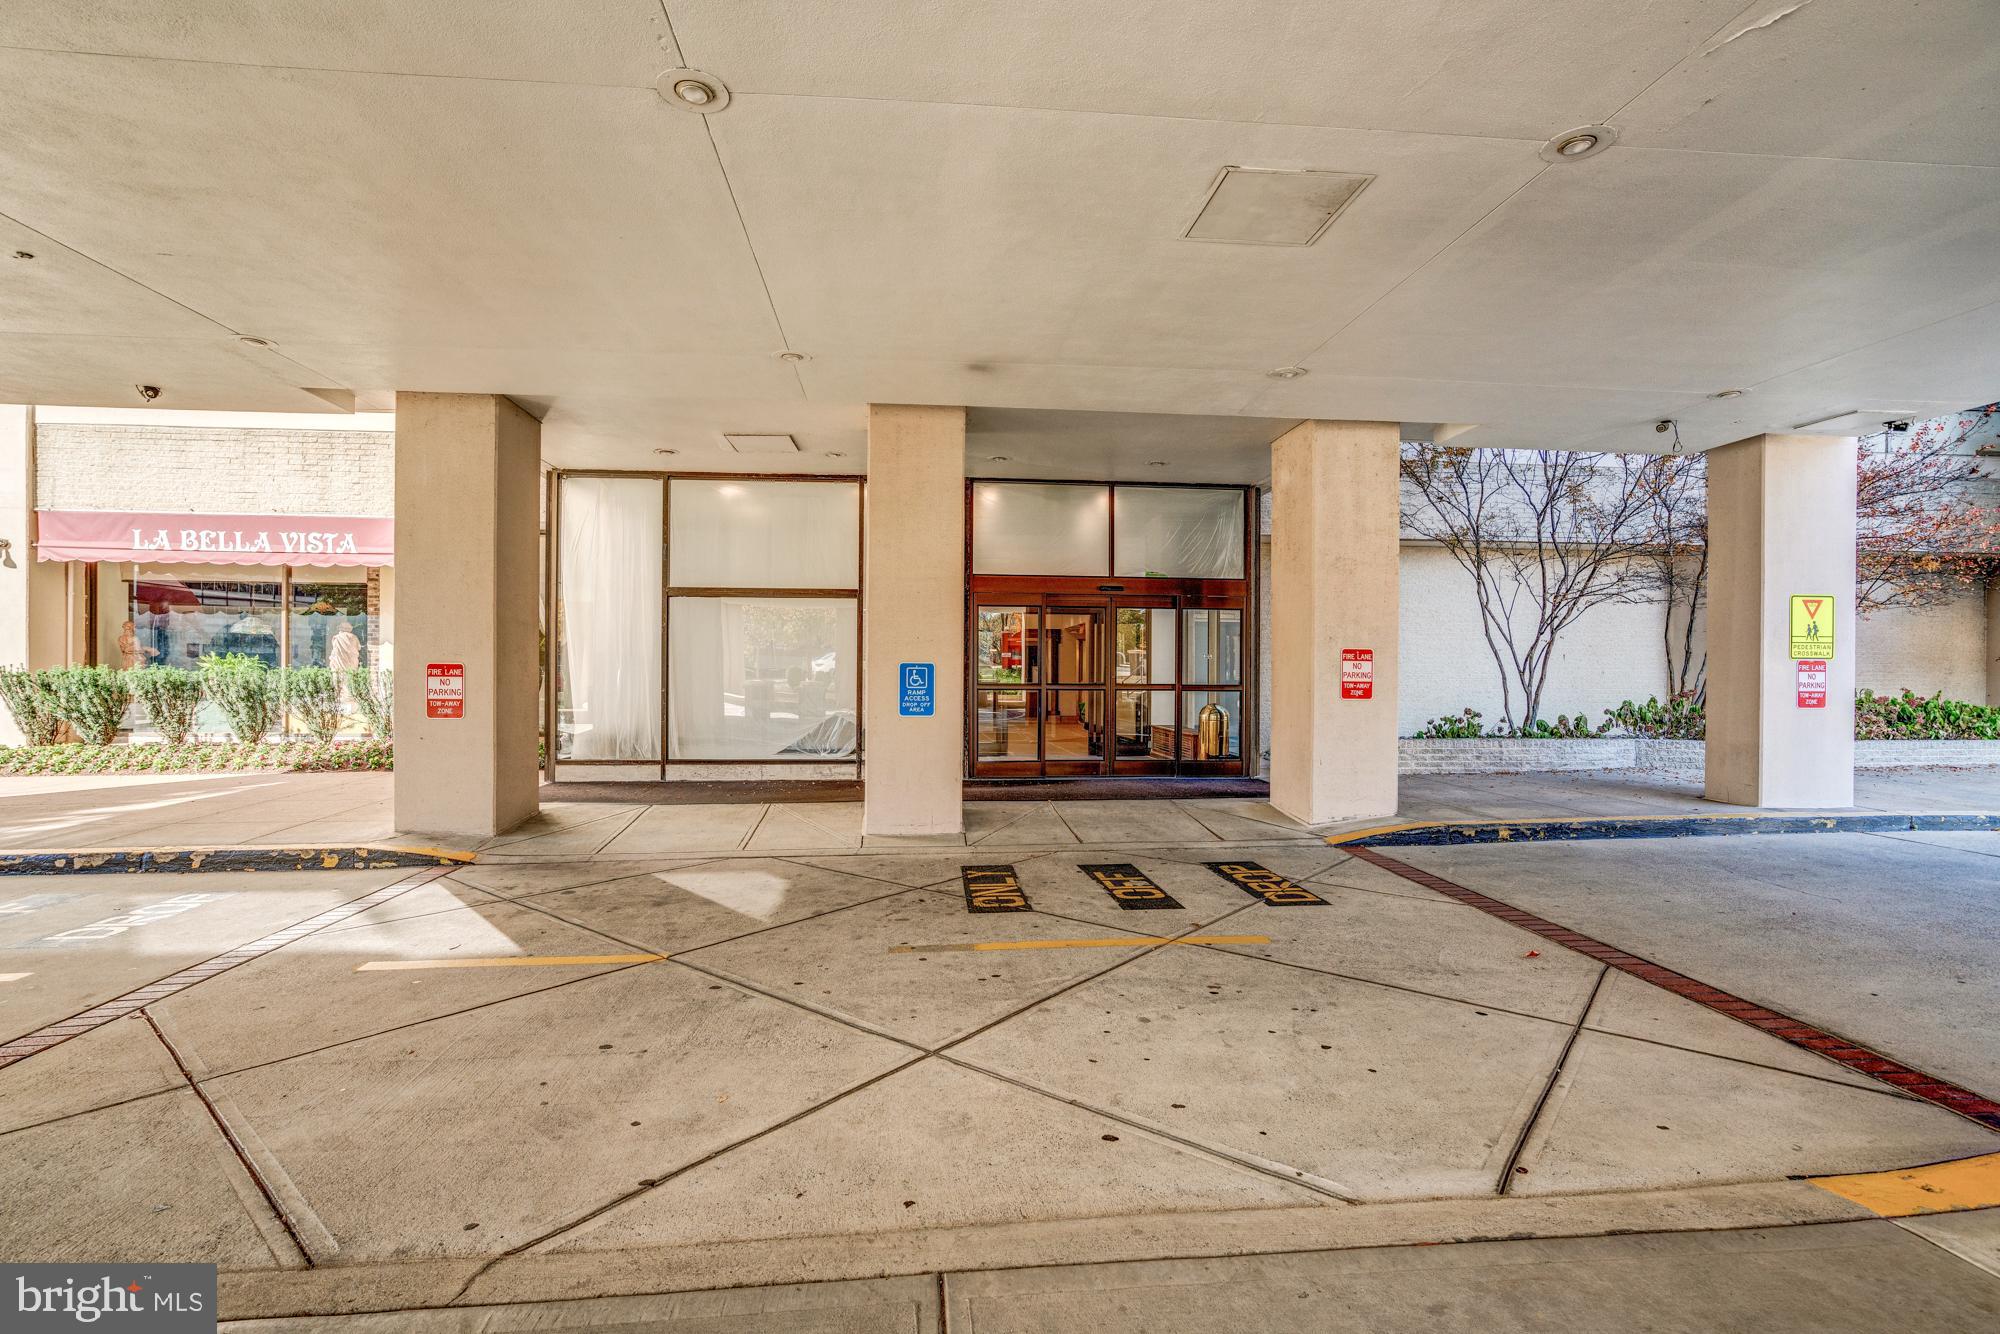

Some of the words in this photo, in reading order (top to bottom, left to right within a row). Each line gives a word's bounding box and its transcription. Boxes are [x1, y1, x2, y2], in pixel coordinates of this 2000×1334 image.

[132, 529, 171, 550] LA
[180, 530, 272, 552] BELLA
[279, 532, 357, 553] VISTA
[1352, 662, 1362, 670] NO
[428, 668, 442, 676] FIRE
[444, 668, 463, 676] LANE
[1343, 671, 1371, 679] PARKING
[439, 678, 451, 686] NO
[1799, 681, 1825, 689] PARKING
[428, 688, 462, 697] PARKING
[1093, 871, 1166, 900] OFF
[1220, 864, 1320, 903] DROP
[966, 870, 1025, 909] ONLY
